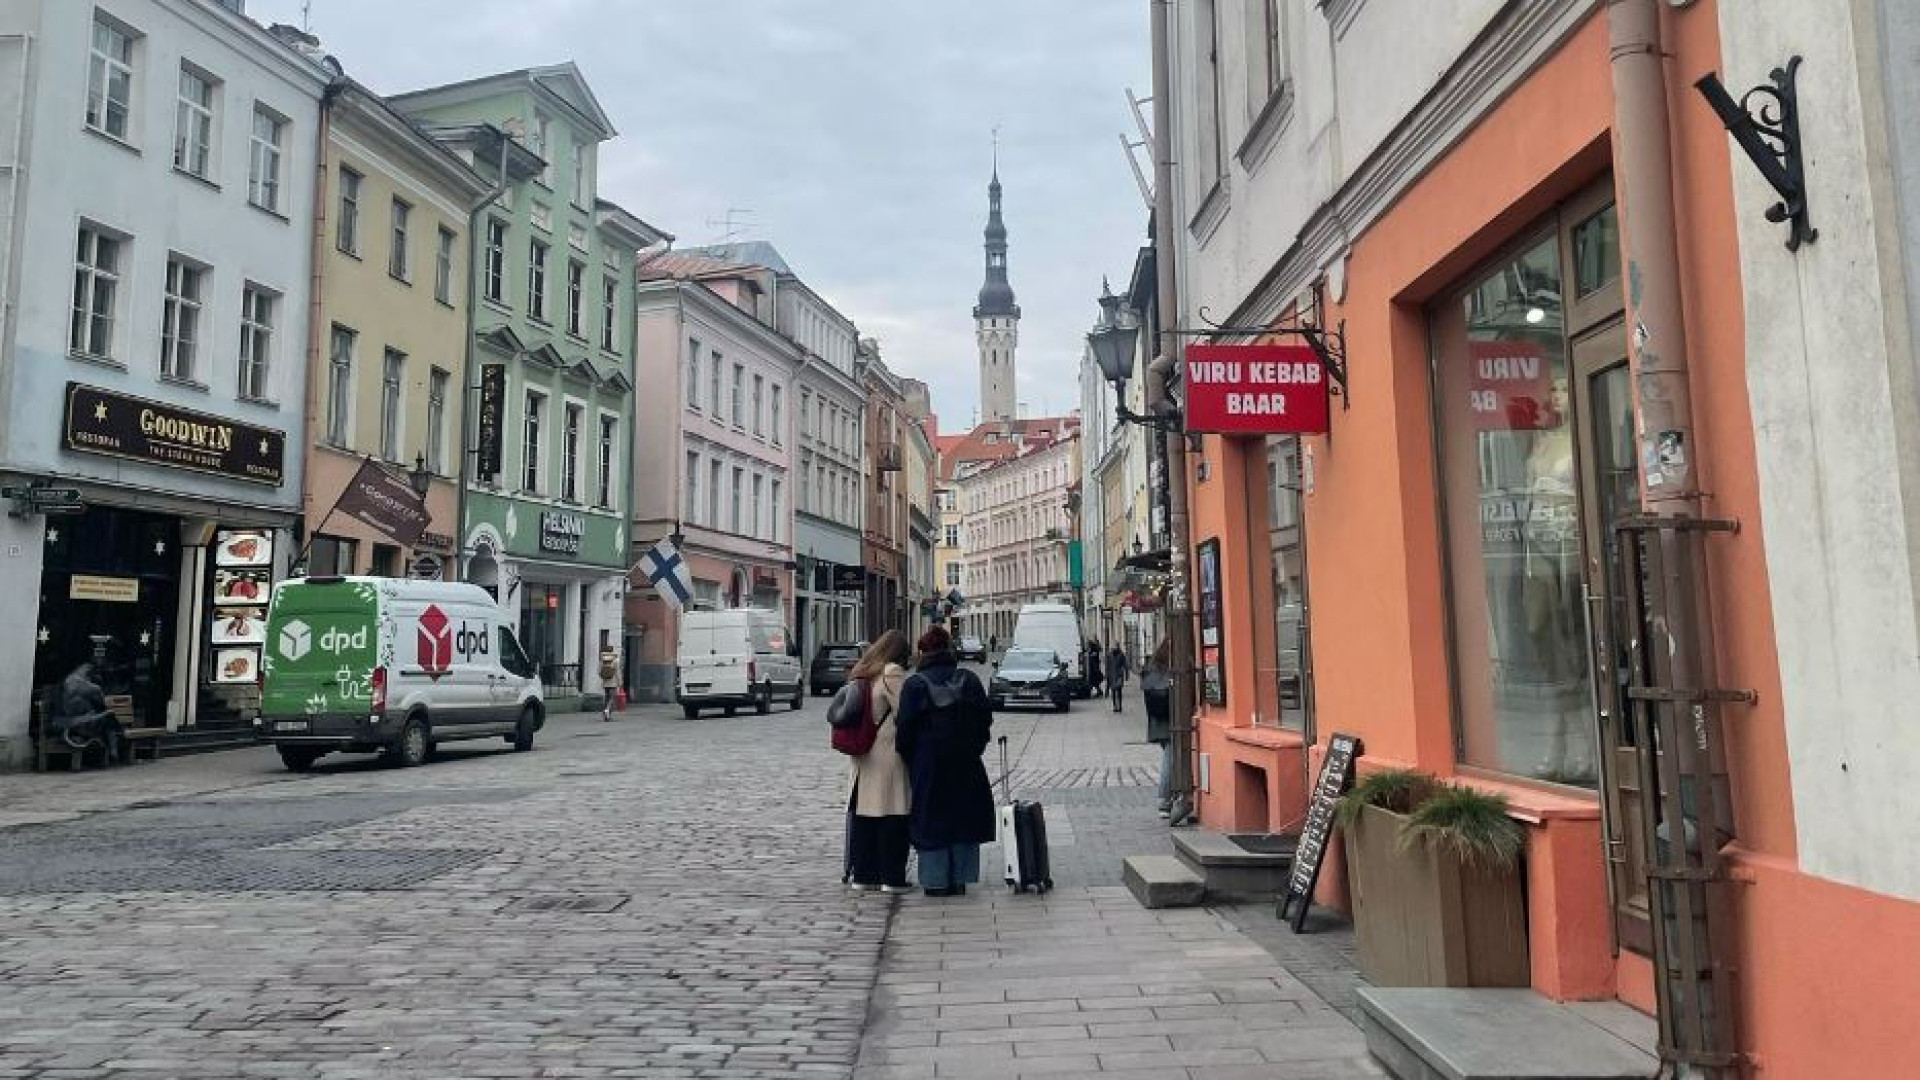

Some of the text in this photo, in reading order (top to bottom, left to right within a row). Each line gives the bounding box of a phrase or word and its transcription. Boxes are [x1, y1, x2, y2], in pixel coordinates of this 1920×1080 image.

[1189, 361, 1320, 383] VIRU KEBAB
[1227, 393, 1285, 414] BAAR
[320, 625, 367, 655] dpd
[456, 620, 489, 662] dpd
